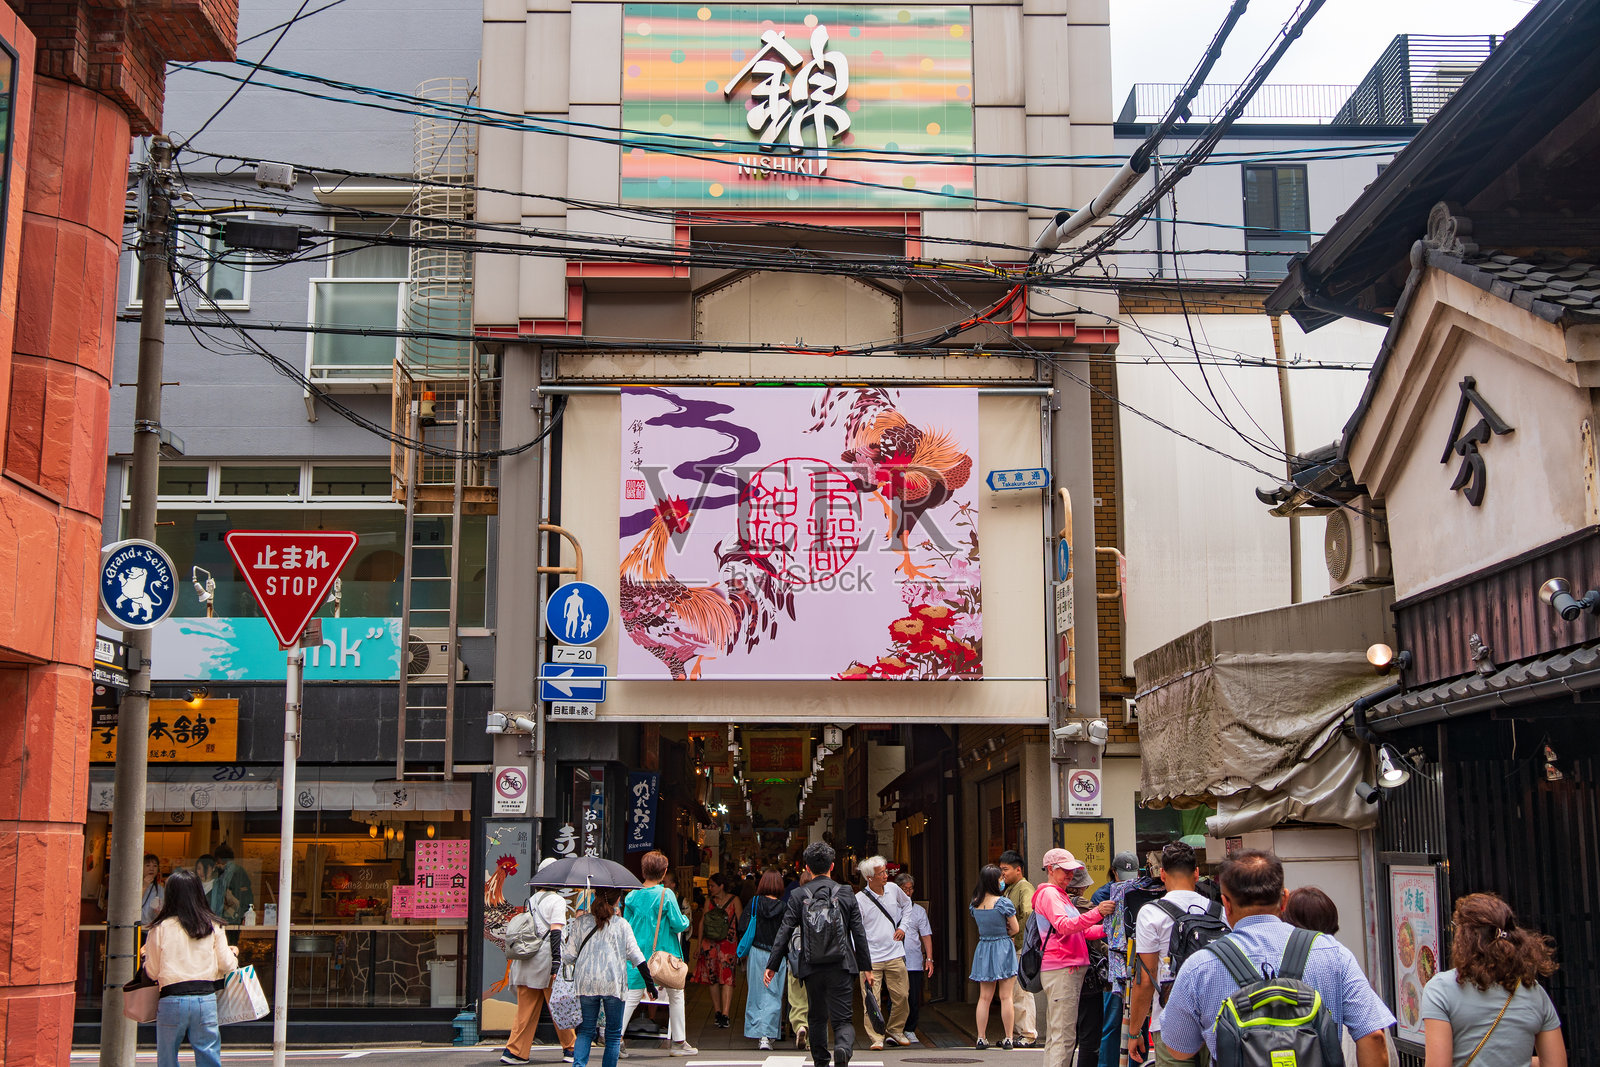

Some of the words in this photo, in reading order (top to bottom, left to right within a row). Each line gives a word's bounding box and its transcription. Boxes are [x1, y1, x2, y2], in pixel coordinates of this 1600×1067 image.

[724, 24, 851, 176] 錦
[738, 157, 813, 176] NISHIKI
[106, 547, 136, 578] Grand
[144, 550, 169, 582] Seiko
[253, 545, 330, 570] 止まれ
[266, 576, 318, 596] STOP
[554, 705, 594, 716] 自転車を除く
[1085, 842, 1095, 863] 若冲
[1095, 831, 1105, 853] 伊藤
